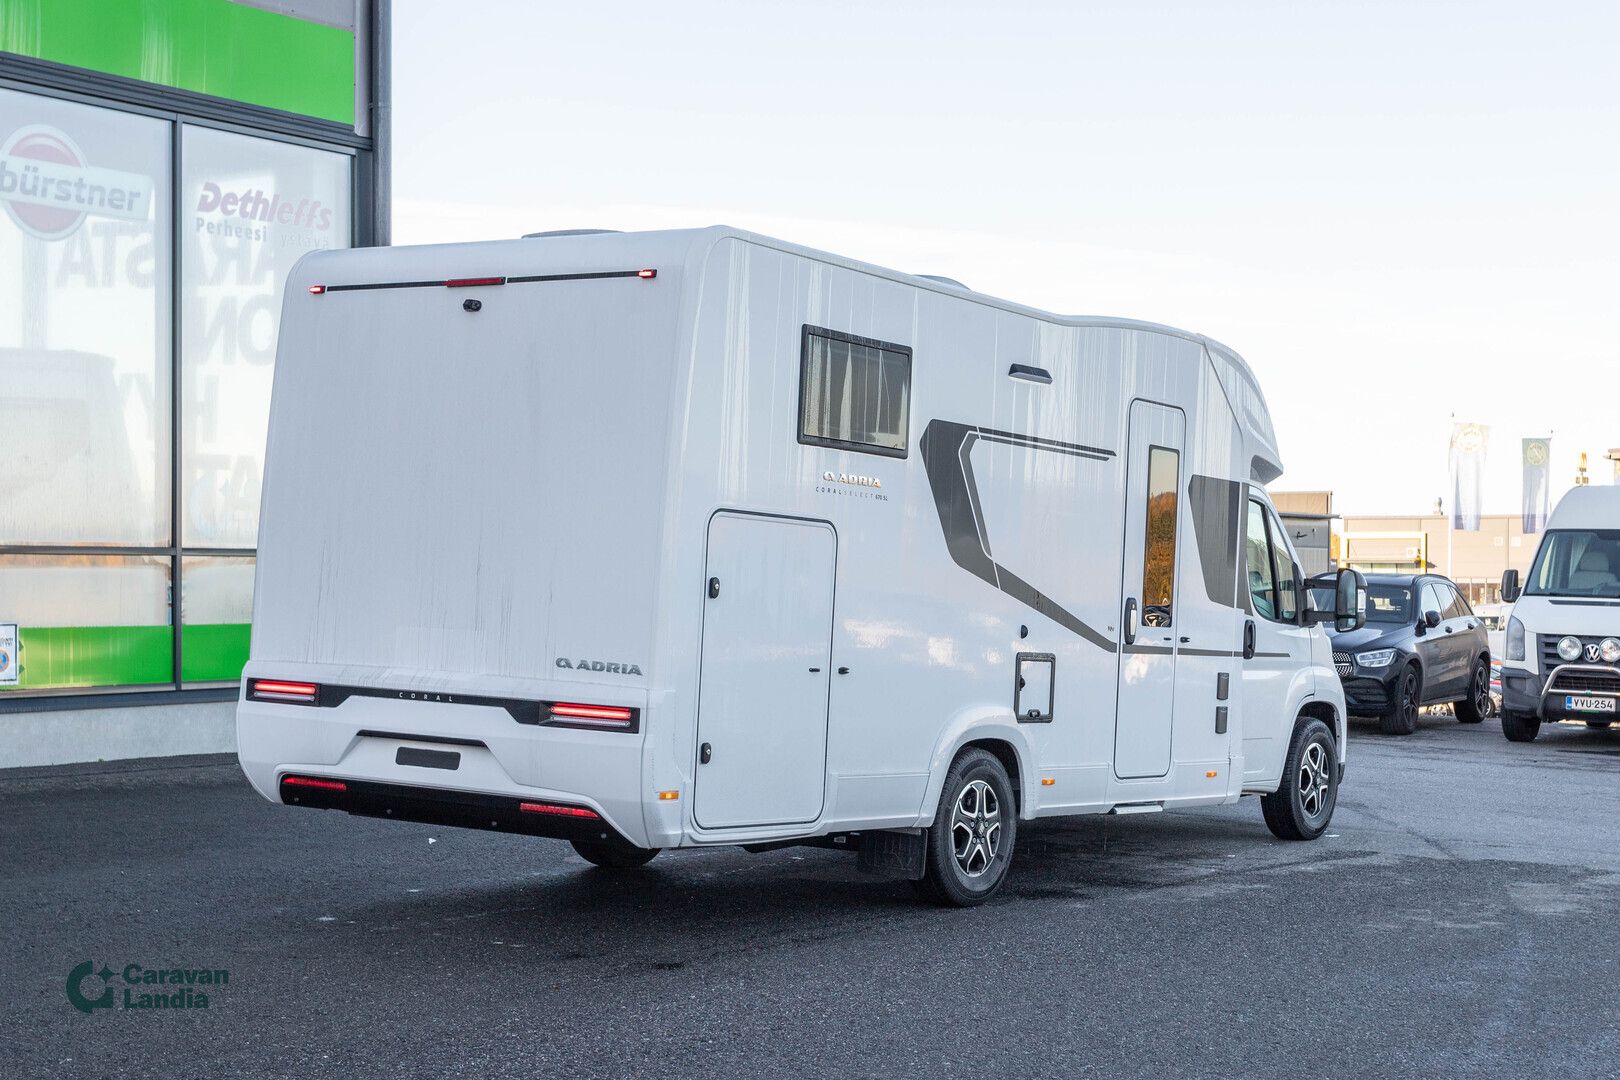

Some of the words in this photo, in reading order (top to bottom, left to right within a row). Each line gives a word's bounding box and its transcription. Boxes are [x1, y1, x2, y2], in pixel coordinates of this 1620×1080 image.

[0, 160, 140, 212] bürstner
[197, 182, 332, 231] Dethleffs
[196, 217, 266, 241] Perheesi
[837, 473, 880, 488] ADRIA
[576, 659, 643, 676] ADRIA
[399, 692, 453, 702] CORAL
